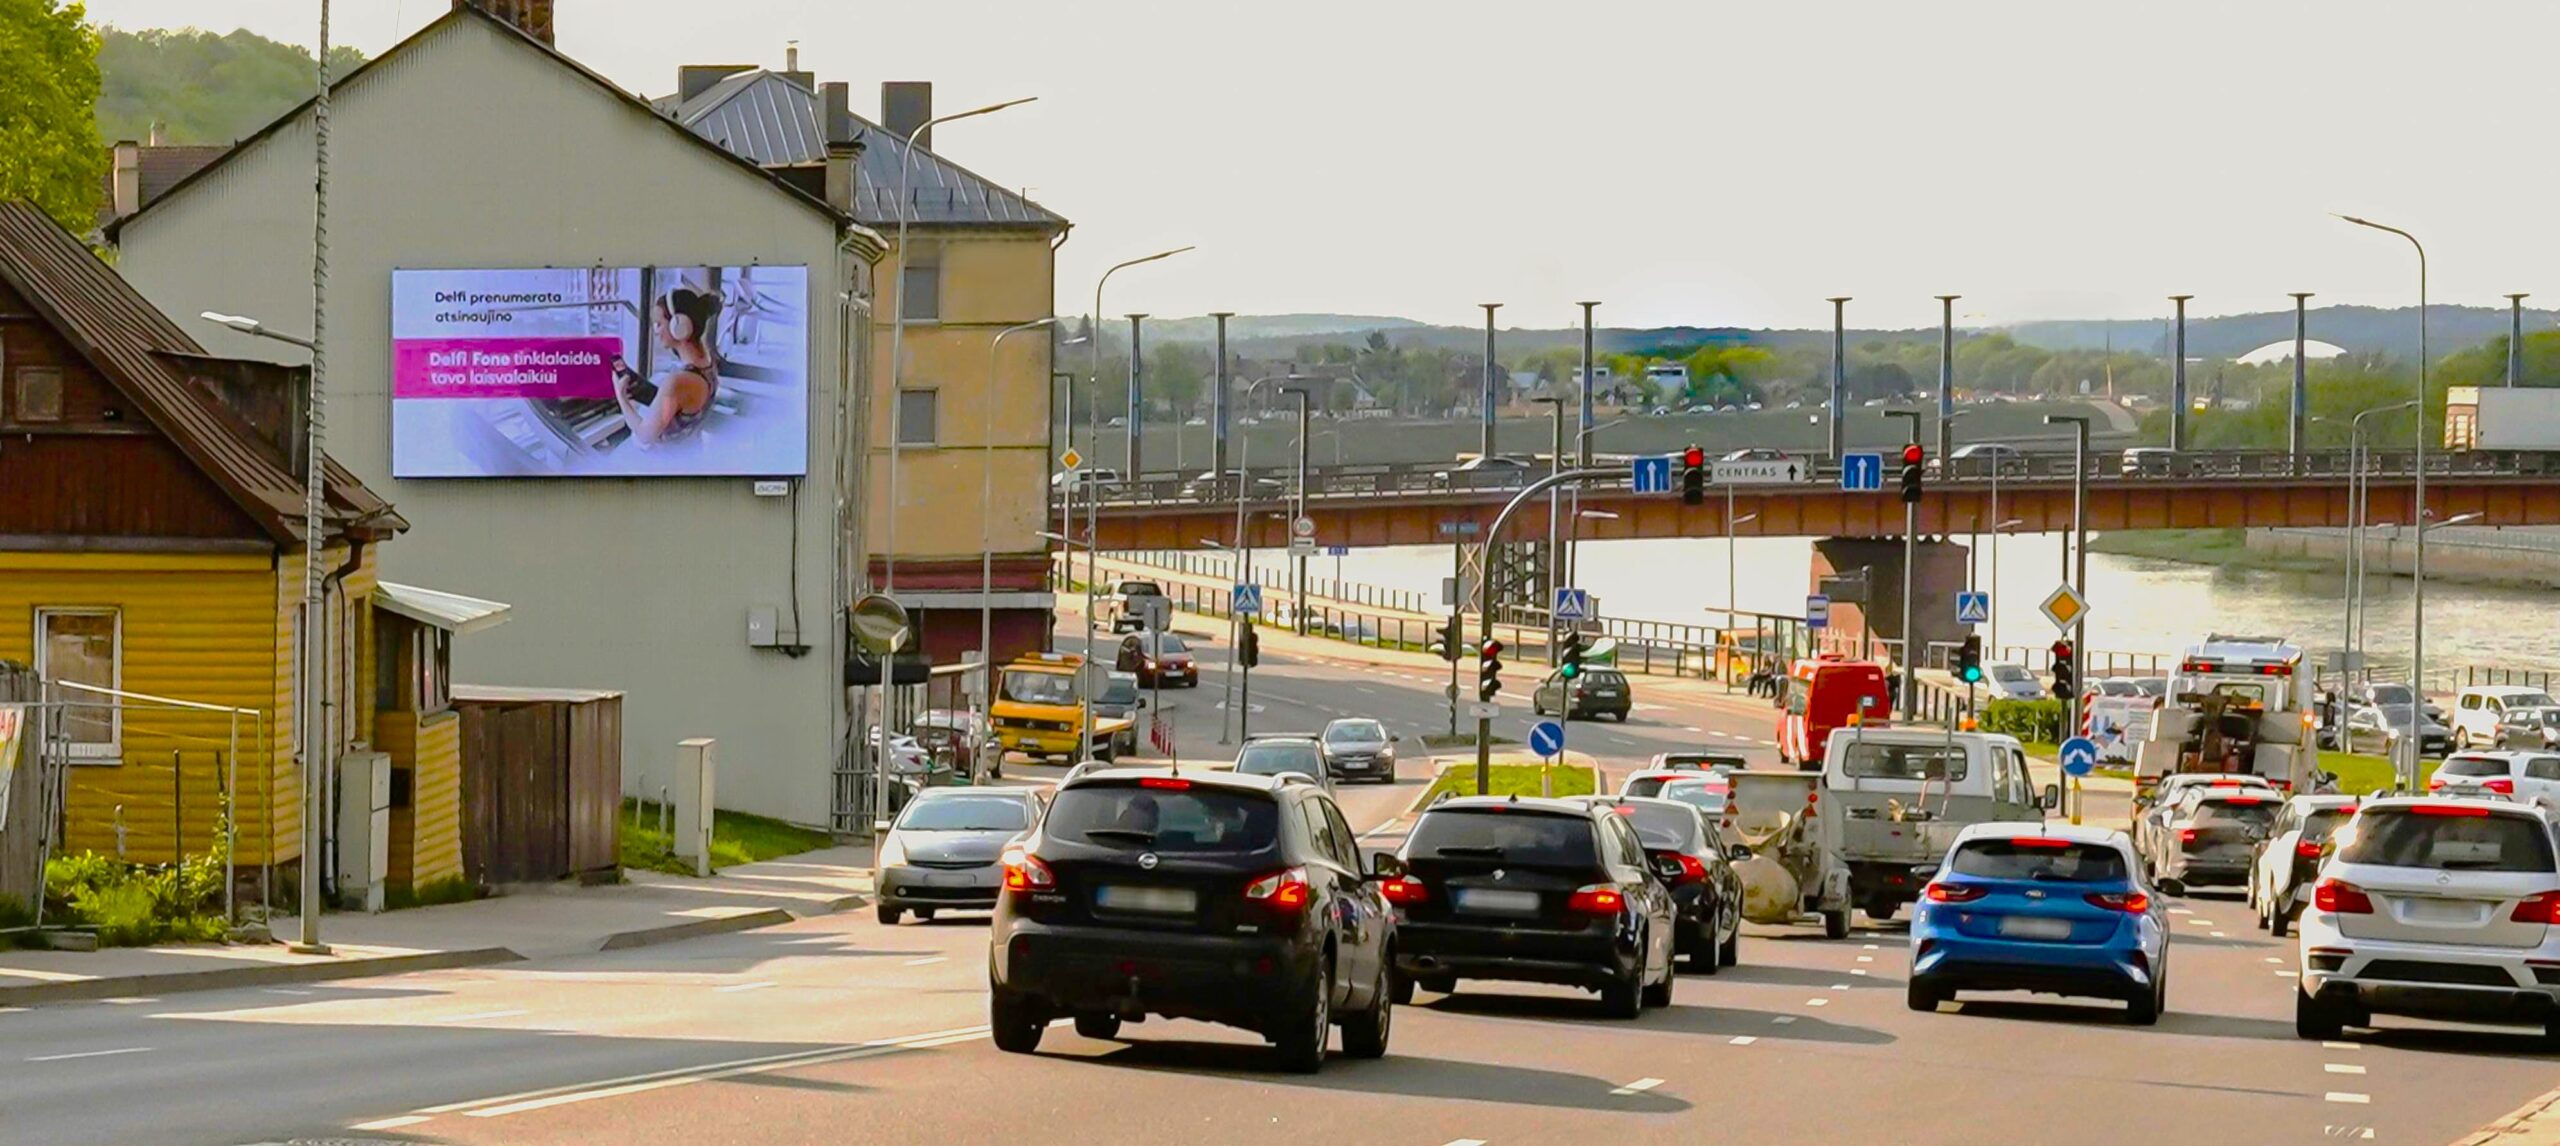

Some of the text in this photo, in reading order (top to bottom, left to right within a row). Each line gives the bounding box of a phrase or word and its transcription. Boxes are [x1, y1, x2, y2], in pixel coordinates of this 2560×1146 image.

[434, 291, 562, 306] Delfi prenumerata
[434, 310, 513, 325] atsinaujino
[429, 350, 601, 366] Delfi Fone tinklalaidės
[430, 368, 558, 385] tavo laisvalaikiui
[1717, 466, 1778, 478] CENTRAS
